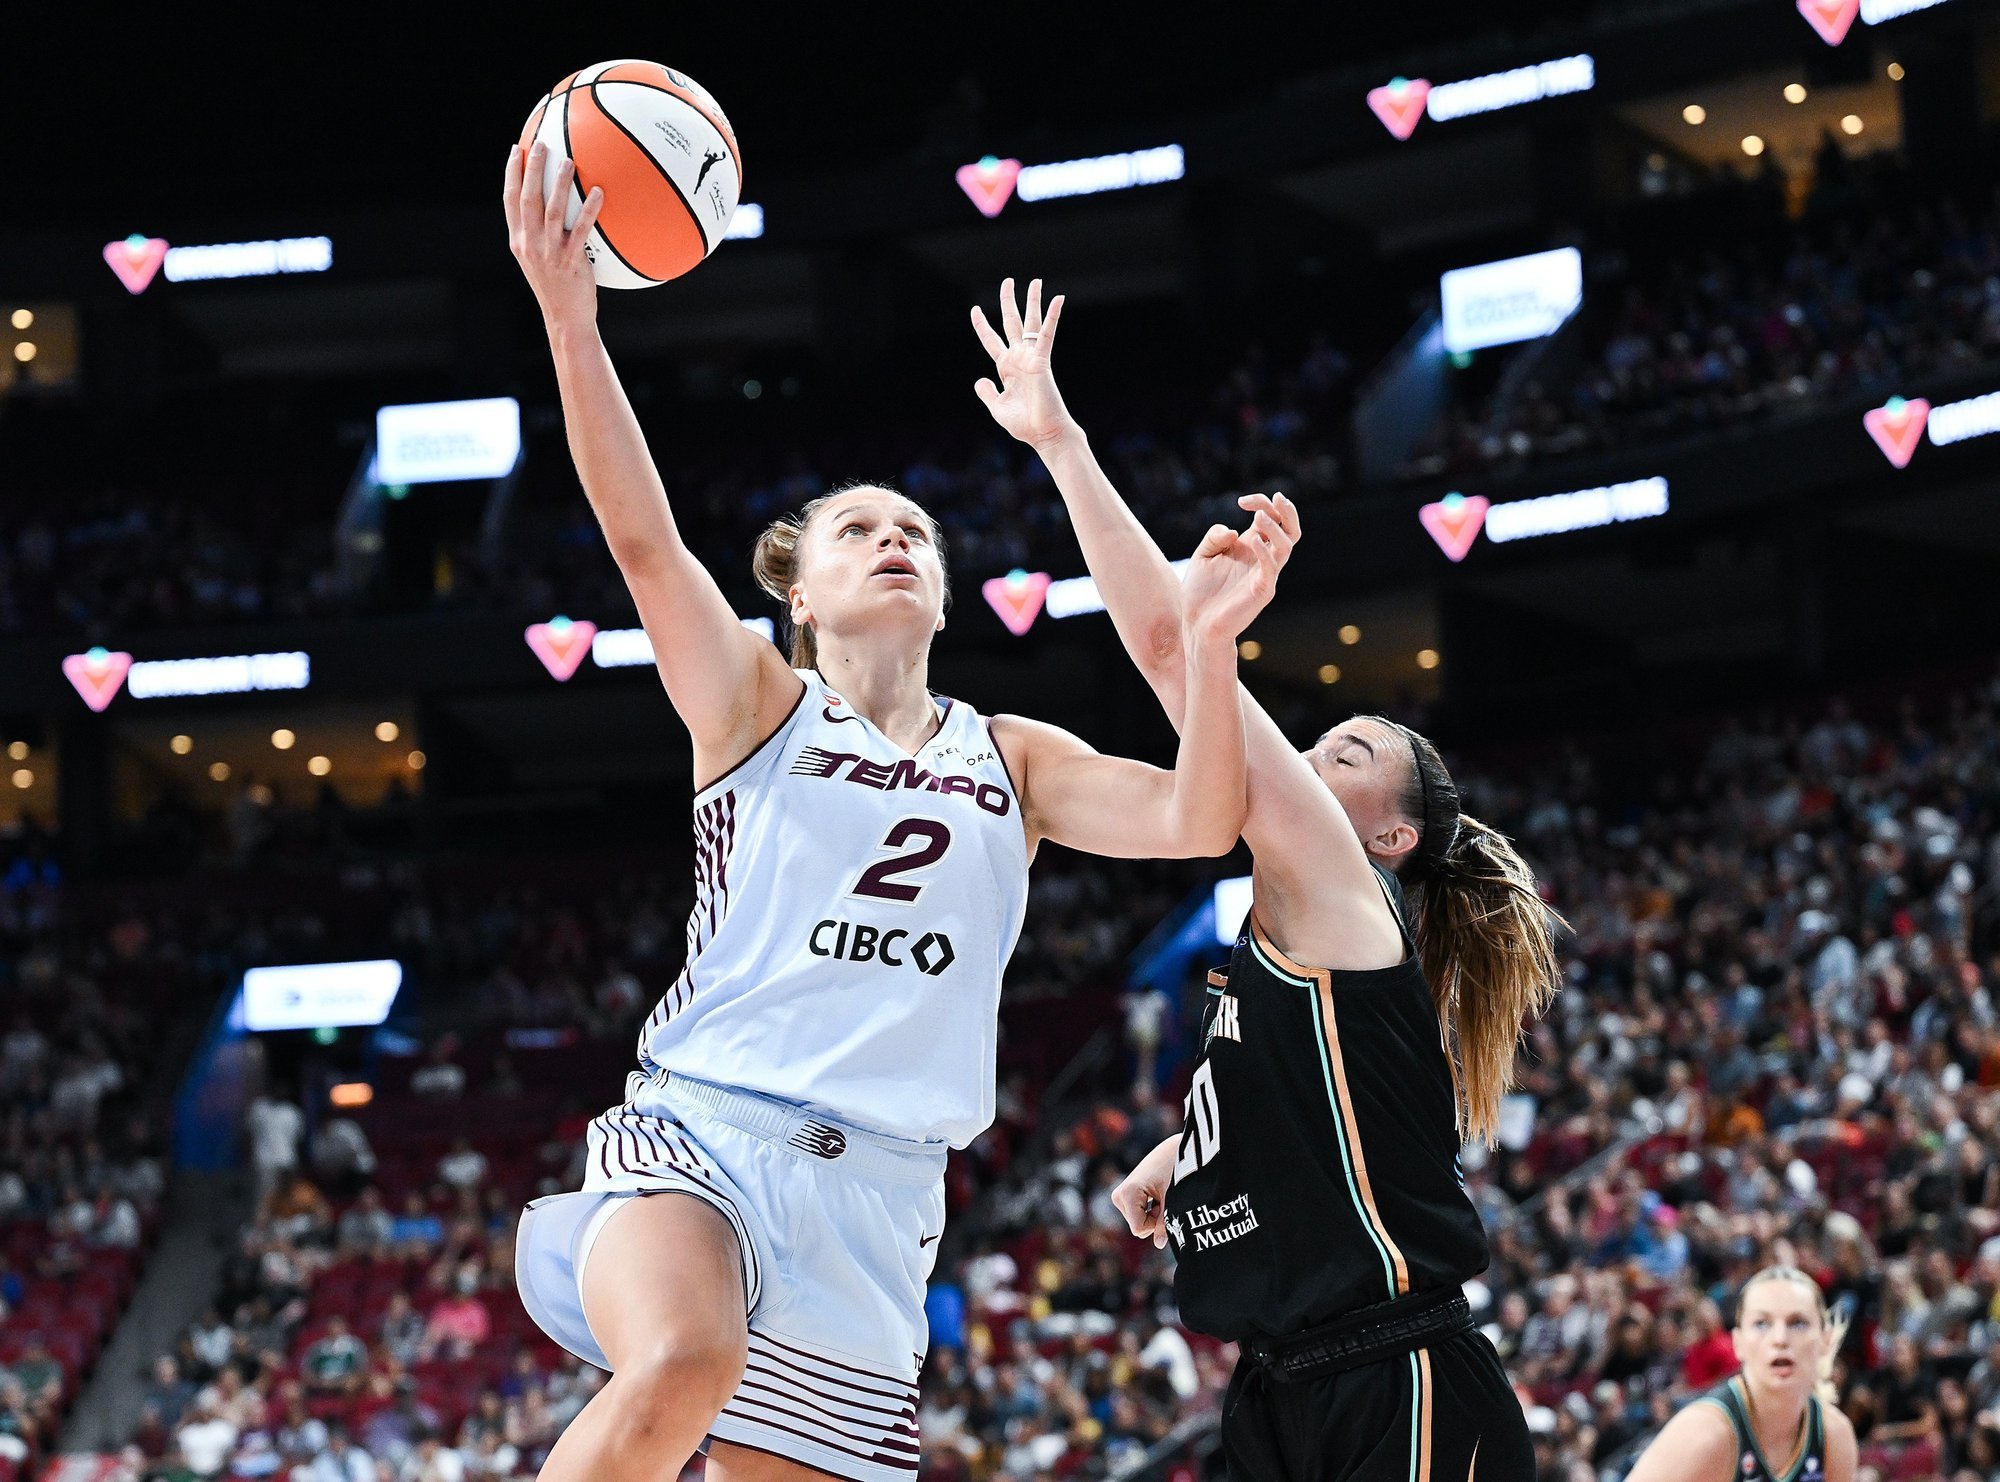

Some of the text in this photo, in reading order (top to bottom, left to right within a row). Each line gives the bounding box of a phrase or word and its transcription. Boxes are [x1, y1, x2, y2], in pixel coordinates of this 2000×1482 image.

[676, 139, 691, 157] BALL
[937, 747, 994, 766] SEORA
[788, 745, 1010, 817] TEMPO
[850, 816, 952, 903] 2
[809, 919, 909, 967] CIBC
[1186, 1193, 1250, 1230] Liberty
[1193, 1209, 1260, 1252] Mutual
